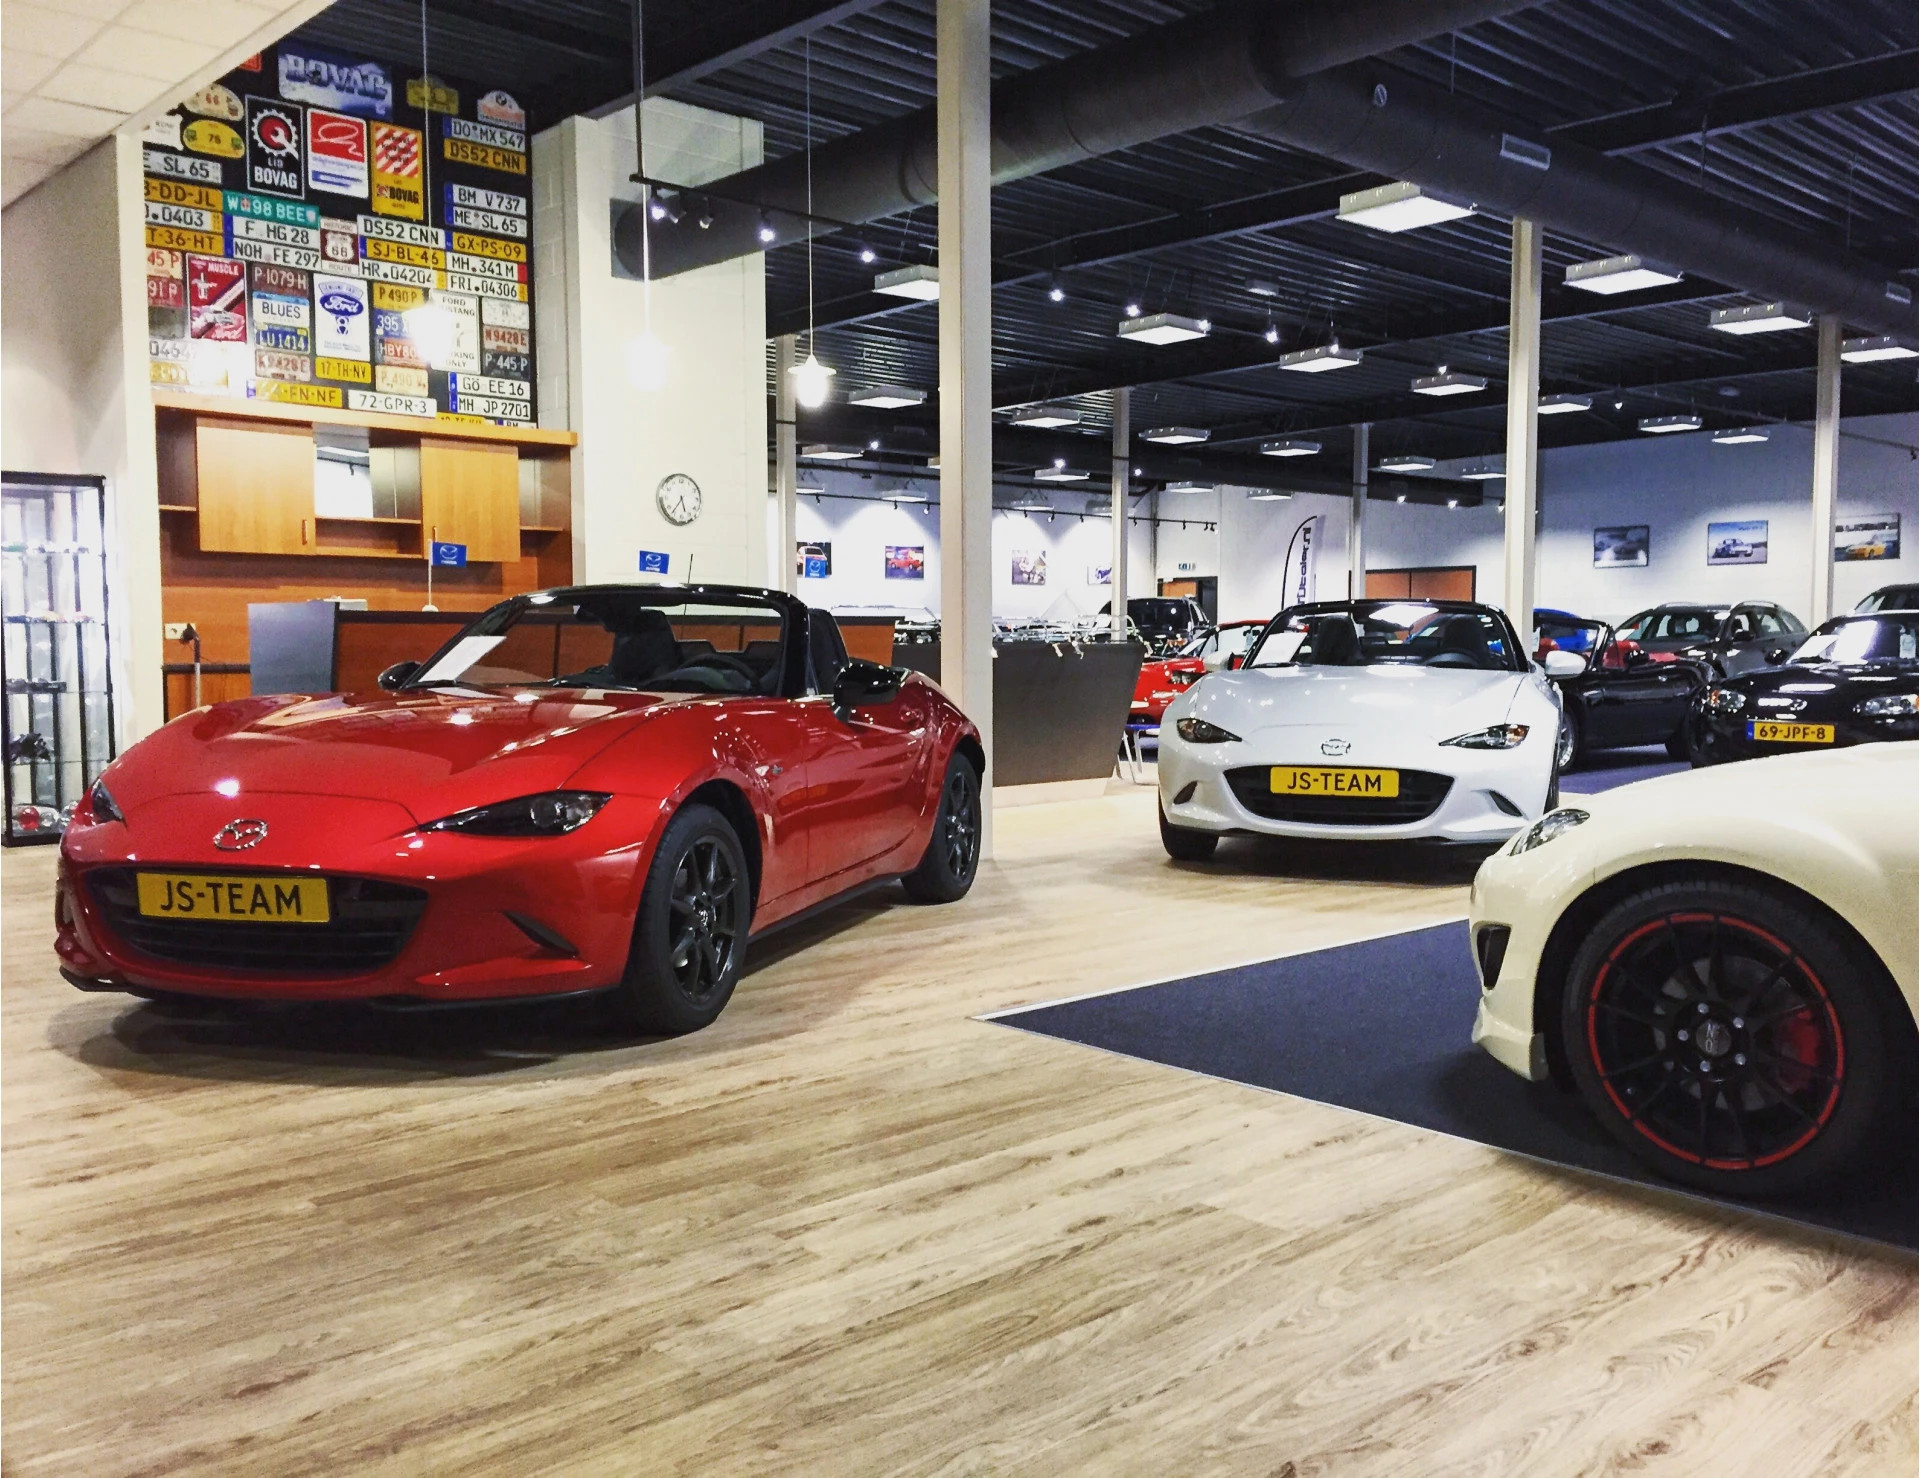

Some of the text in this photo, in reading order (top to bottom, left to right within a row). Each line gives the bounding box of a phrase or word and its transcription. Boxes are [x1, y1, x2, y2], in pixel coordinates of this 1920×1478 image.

[285, 54, 388, 100] BOVAG
[499, 132, 524, 149] 547
[450, 142, 520, 170] DS52 CNN
[163, 156, 210, 179] SL 65
[254, 166, 298, 189] BOVAG
[389, 185, 419, 205] BOVAG
[458, 187, 477, 204] BM
[252, 199, 272, 216] 98
[276, 203, 305, 222] BEE
[454, 210, 518, 233] ME SL 65
[245, 220, 310, 245] F HG 28
[363, 218, 439, 245] DS52 CNN
[234, 241, 320, 268] NOH FE 297
[373, 242, 439, 265] SJ-BL-46
[456, 235, 522, 259] GX-PS-09
[262, 302, 301, 319] BLUES
[324, 295, 359, 313] Ford
[377, 315, 399, 332] 395
[260, 381, 337, 403] -FN-NF
[489, 380, 506, 394] EE
[509, 382, 525, 396] 16
[360, 394, 427, 414] 72-GPR-3
[458, 397, 530, 418] MH JP 2701
[1759, 725, 1826, 740] 69-JPF-8
[1287, 772, 1382, 792] JS-TEAM
[160, 880, 303, 916] JS-TEAM
